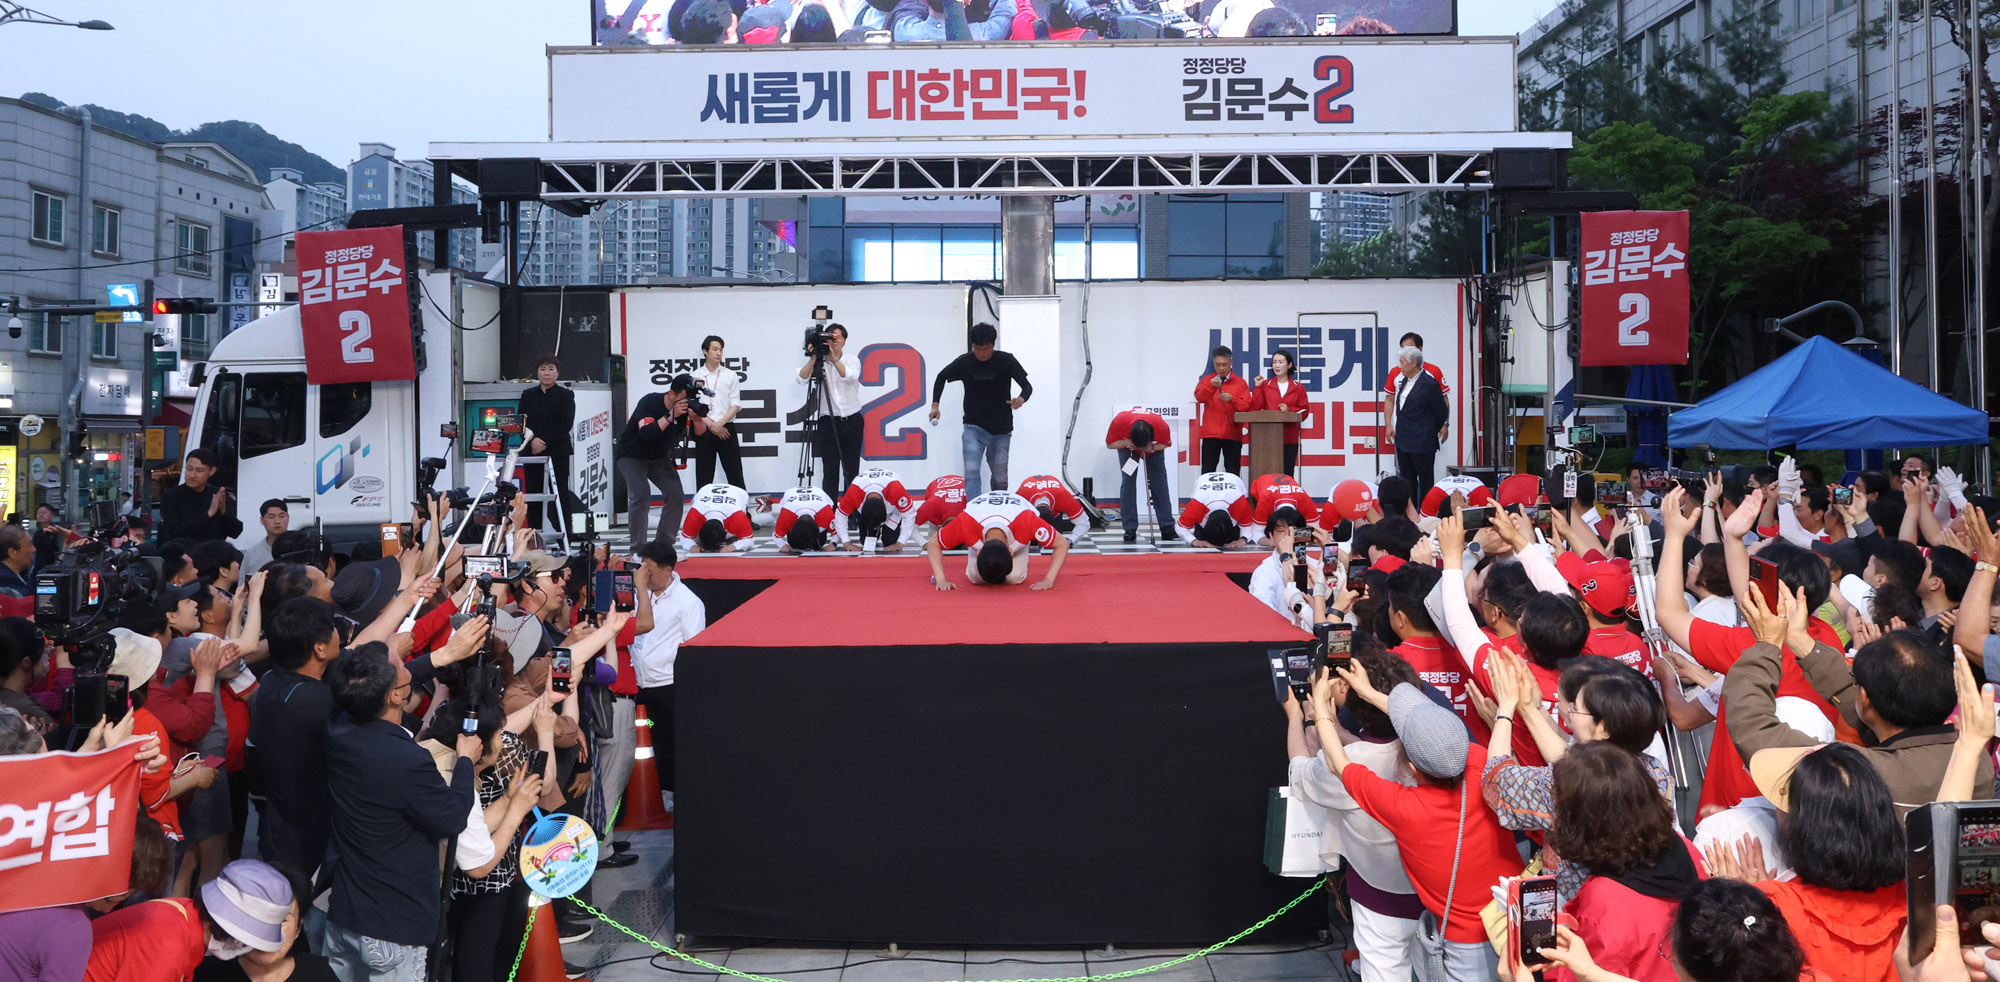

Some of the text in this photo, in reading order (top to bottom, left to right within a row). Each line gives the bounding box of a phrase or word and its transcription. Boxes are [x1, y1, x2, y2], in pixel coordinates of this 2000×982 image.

[1183, 58, 1247, 75] 정정당당
[700, 67, 1088, 124] 새롭게 대한민국!
[1183, 55, 1354, 124] 김문수 2
[1610, 228, 1660, 246] 정정당당
[324, 244, 375, 264] 정정당당
[1584, 242, 1686, 286] 김문수
[301, 258, 403, 306] 김문수
[1618, 292, 1650, 347] 2
[338, 309, 375, 364] 2
[98, 383, 131, 399] 전자담배
[858, 343, 928, 461] 2
[580, 458, 608, 511] 김문수
[1199, 482, 1237, 491] 김문수
[1266, 484, 1305, 494] 김문수
[699, 495, 737, 506] 김문수
[786, 494, 823, 503] 김문수
[971, 496, 1021, 506] 김문수
[1581, 579, 1598, 595] 2
[1419, 671, 1461, 684] 정정당당
[1291, 831, 1323, 839] HYUNDAI
